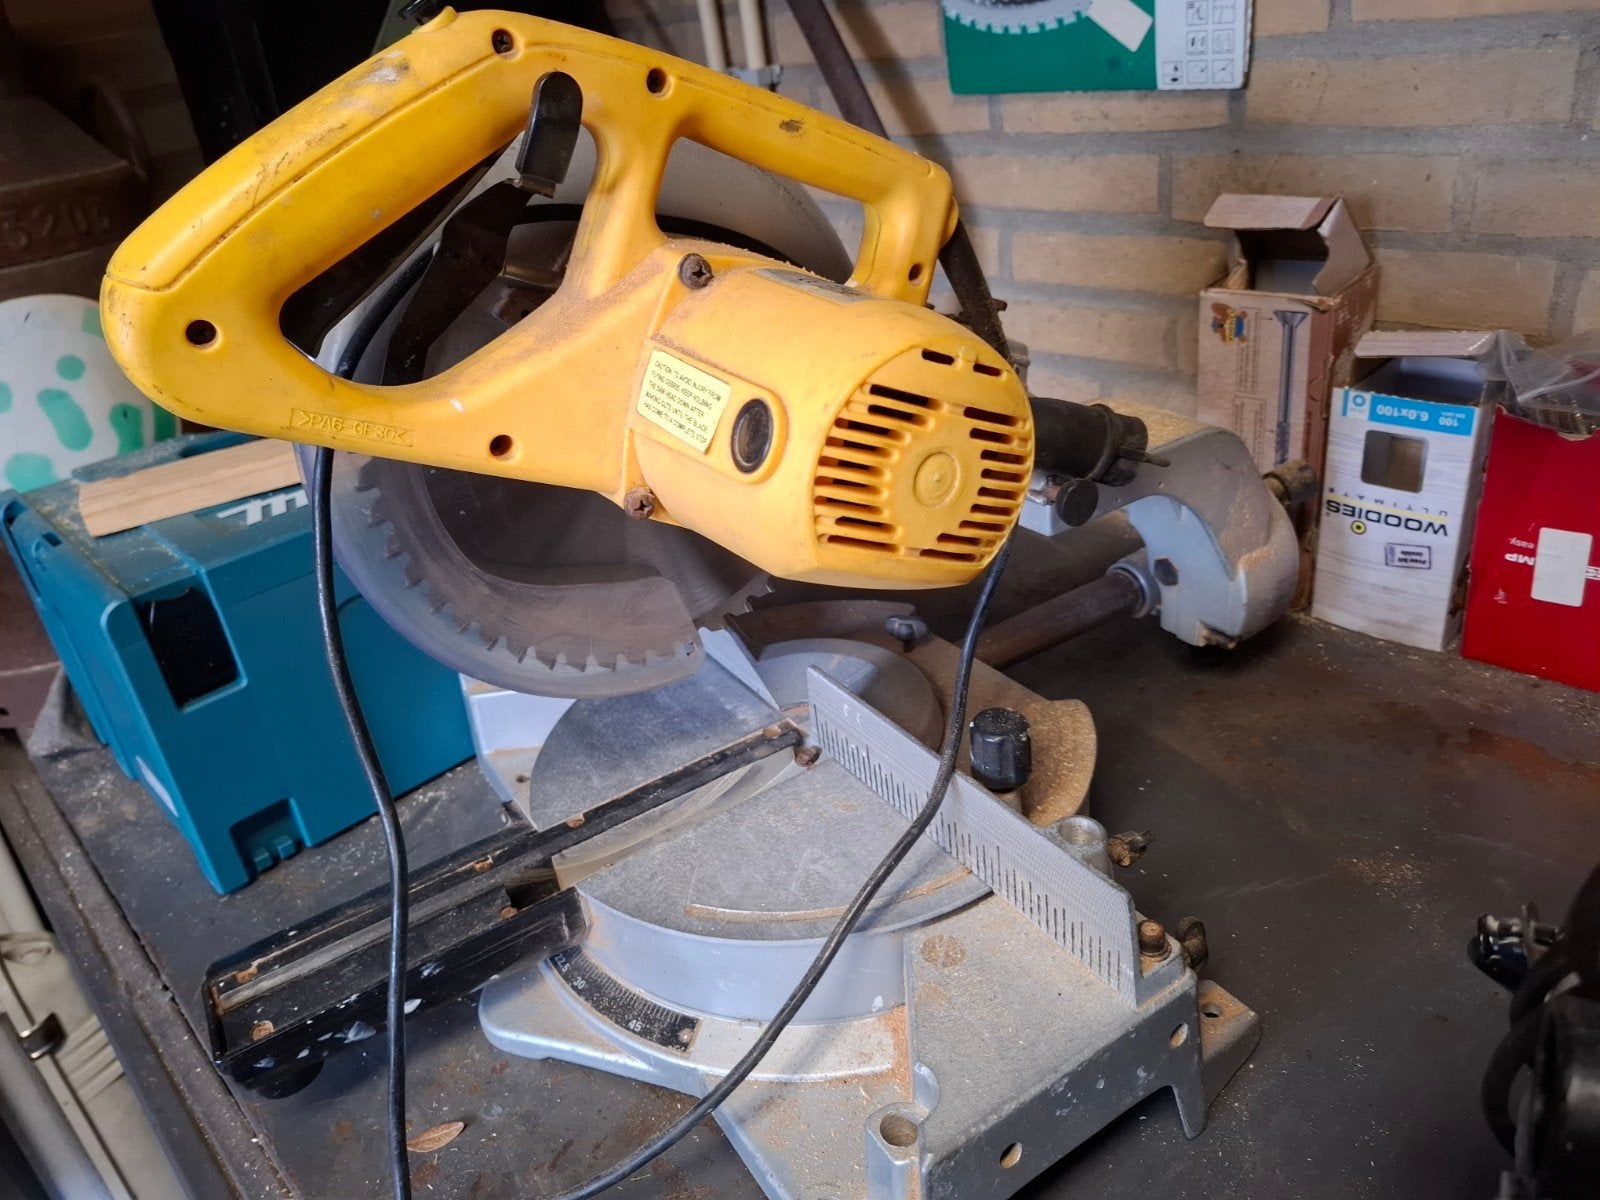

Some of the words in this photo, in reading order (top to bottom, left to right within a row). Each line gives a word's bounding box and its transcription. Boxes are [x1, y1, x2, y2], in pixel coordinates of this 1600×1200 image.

[708, 389, 722, 401] FROM
[1376, 404, 1429, 422] 6.0x100
[1438, 416, 1460, 428] 100
[1328, 487, 1449, 517] ULTIMATE
[1326, 499, 1449, 536] WOODIES
[554, 954, 571, 973] 22.5
